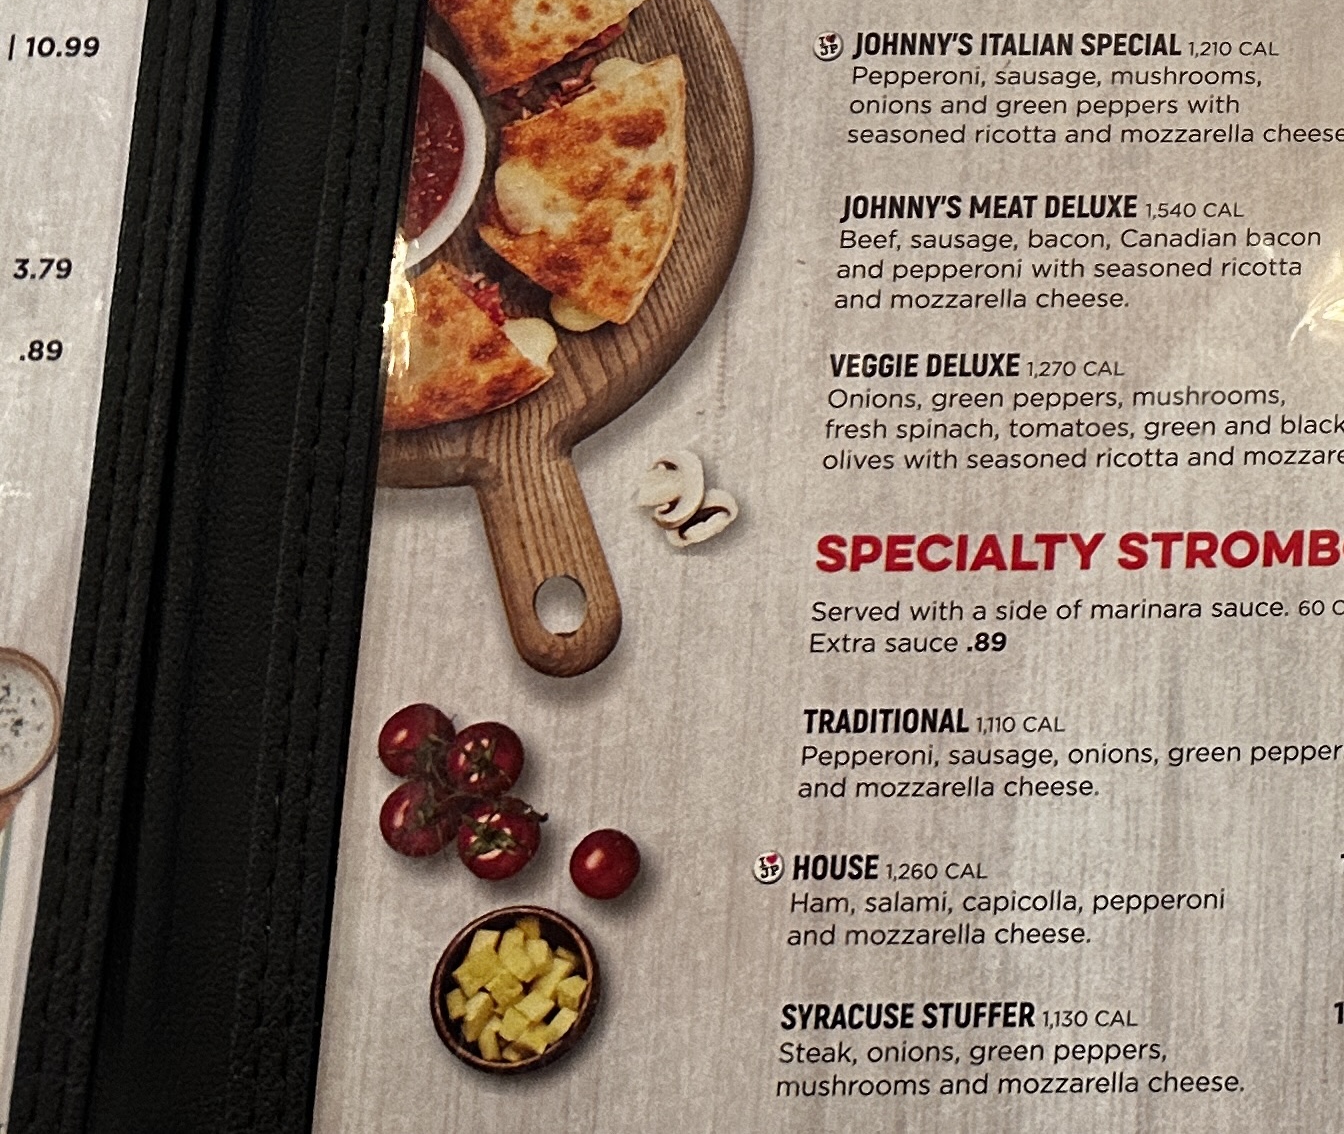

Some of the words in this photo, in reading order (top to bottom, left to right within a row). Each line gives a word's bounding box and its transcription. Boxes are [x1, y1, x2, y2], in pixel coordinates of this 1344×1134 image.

[852, 32, 973, 58] JOHNNY'S
[980, 33, 1073, 57] ITALIAN
[1081, 33, 1181, 56] SPECIAL
[1189, 42, 1232, 58] 1,210
[1239, 42, 1279, 56] CAL
[13, 258, 72, 280] 3.79
[20, 339, 63, 361] .89
[816, 533, 1106, 573] SPECIALTY
[781, 1003, 914, 1030] SYRACUSE
[922, 1002, 1035, 1029] STUFFER
[1043, 1010, 1087, 1029] 1,130
[1095, 1010, 1138, 1026] CAL
[777, 1074, 930, 1096] mushrooms
[940, 1073, 988, 1094] and
[998, 1071, 1138, 1094] mozzarella
[1148, 1071, 1245, 1093] cheese.
